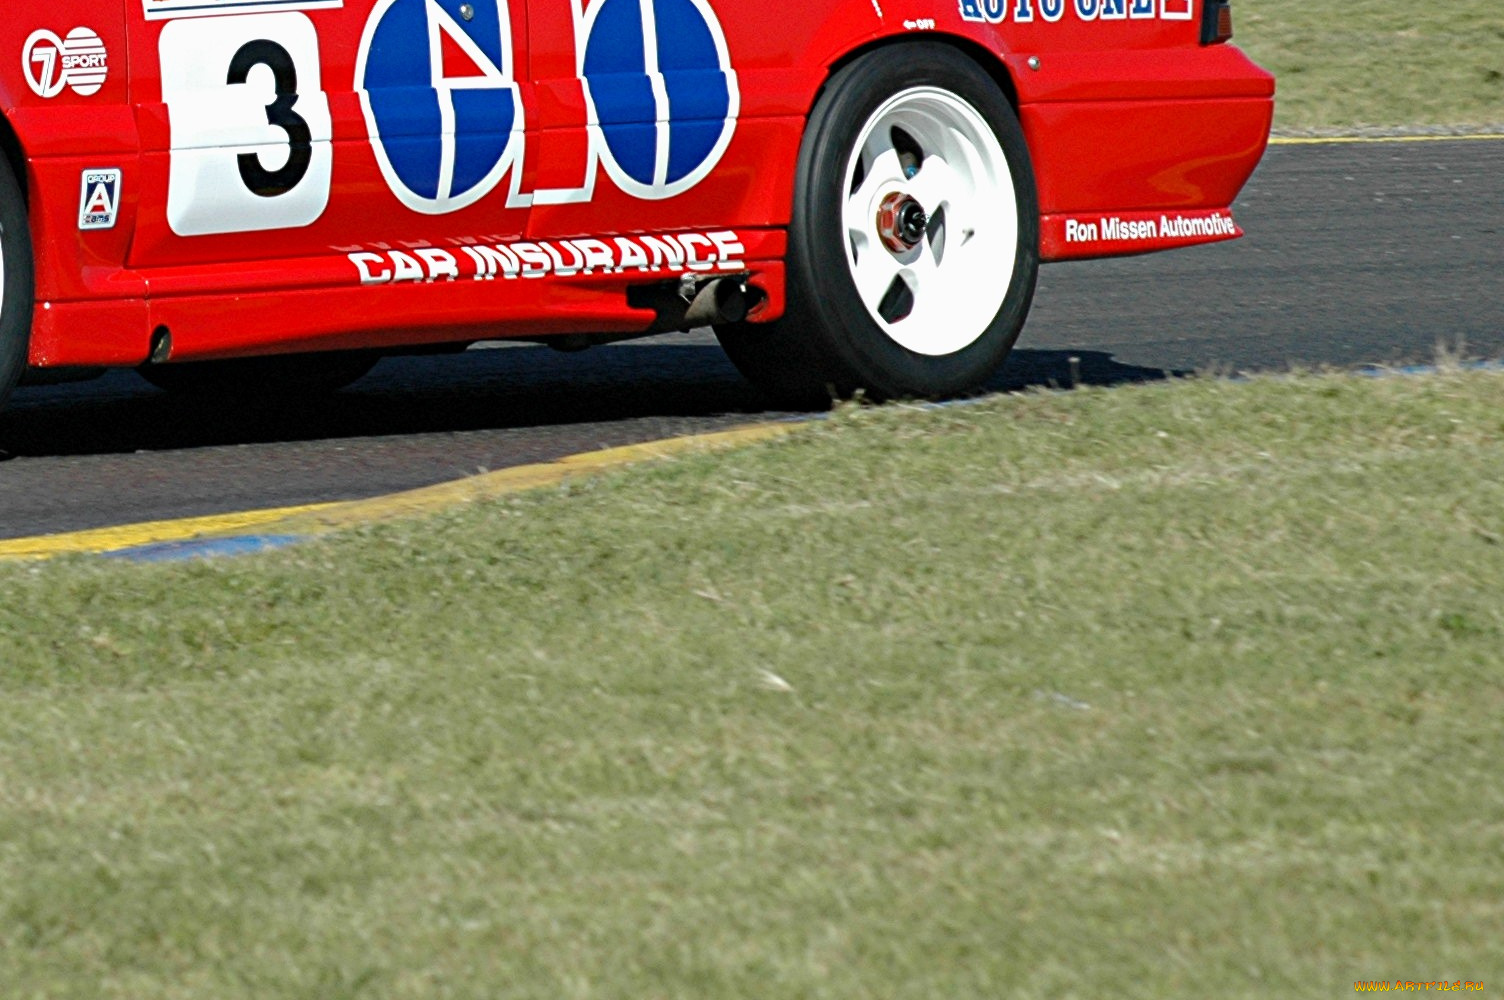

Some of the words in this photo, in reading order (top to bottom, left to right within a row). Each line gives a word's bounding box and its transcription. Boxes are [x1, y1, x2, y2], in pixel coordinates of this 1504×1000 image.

[916, 18, 935, 31] OFF
[31, 47, 57, 97] 7
[61, 54, 107, 69] SPORT
[225, 38, 313, 198] 3
[83, 182, 113, 214] A
[1065, 218, 1098, 242] Ron
[1100, 216, 1156, 240] Missen
[1159, 212, 1236, 238] Automotive
[347, 247, 459, 285] CAR
[459, 230, 746, 282] INSURANCE
